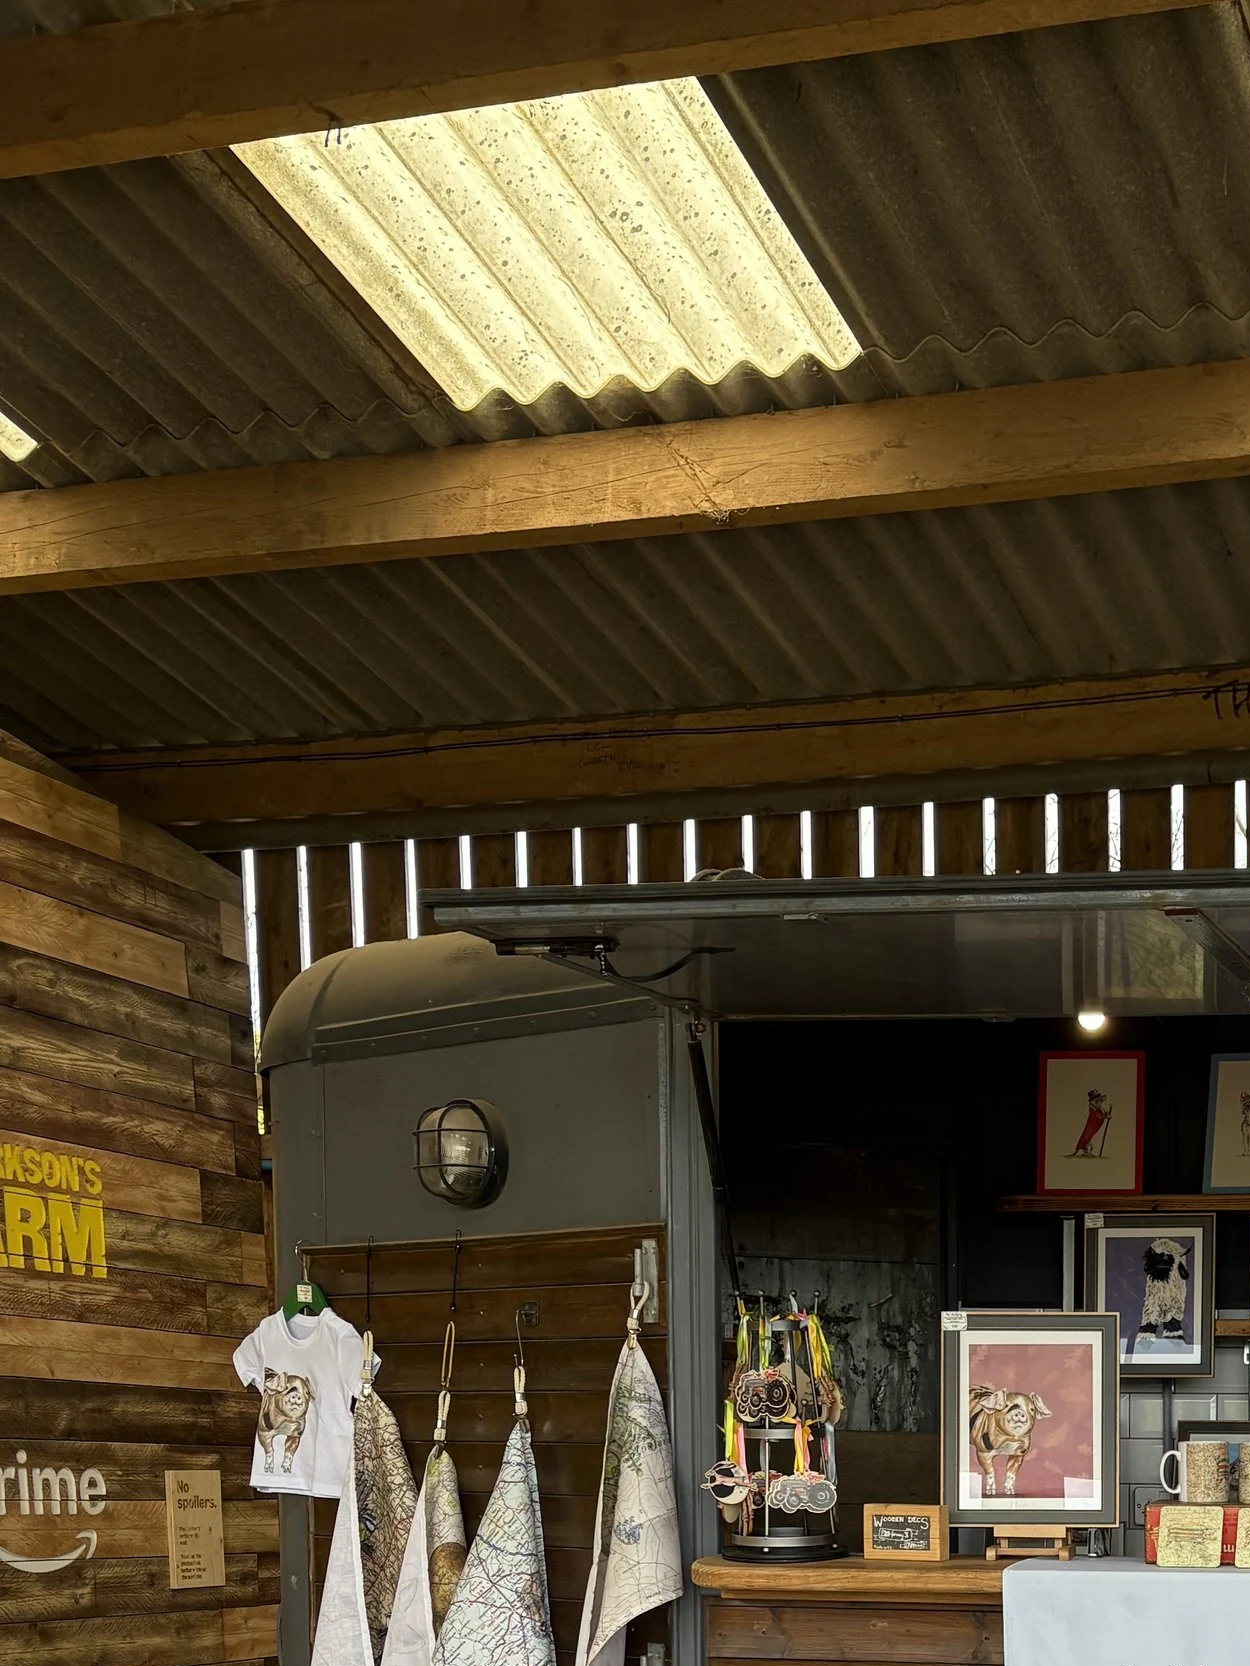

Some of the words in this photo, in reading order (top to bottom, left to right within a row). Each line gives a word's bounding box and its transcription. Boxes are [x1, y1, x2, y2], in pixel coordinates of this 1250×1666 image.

[0, 1186, 108, 1279] RM
[0, 1449, 107, 1516] rime
[177, 1480, 190, 1494] No
[177, 1495, 217, 1511] spoilers.
